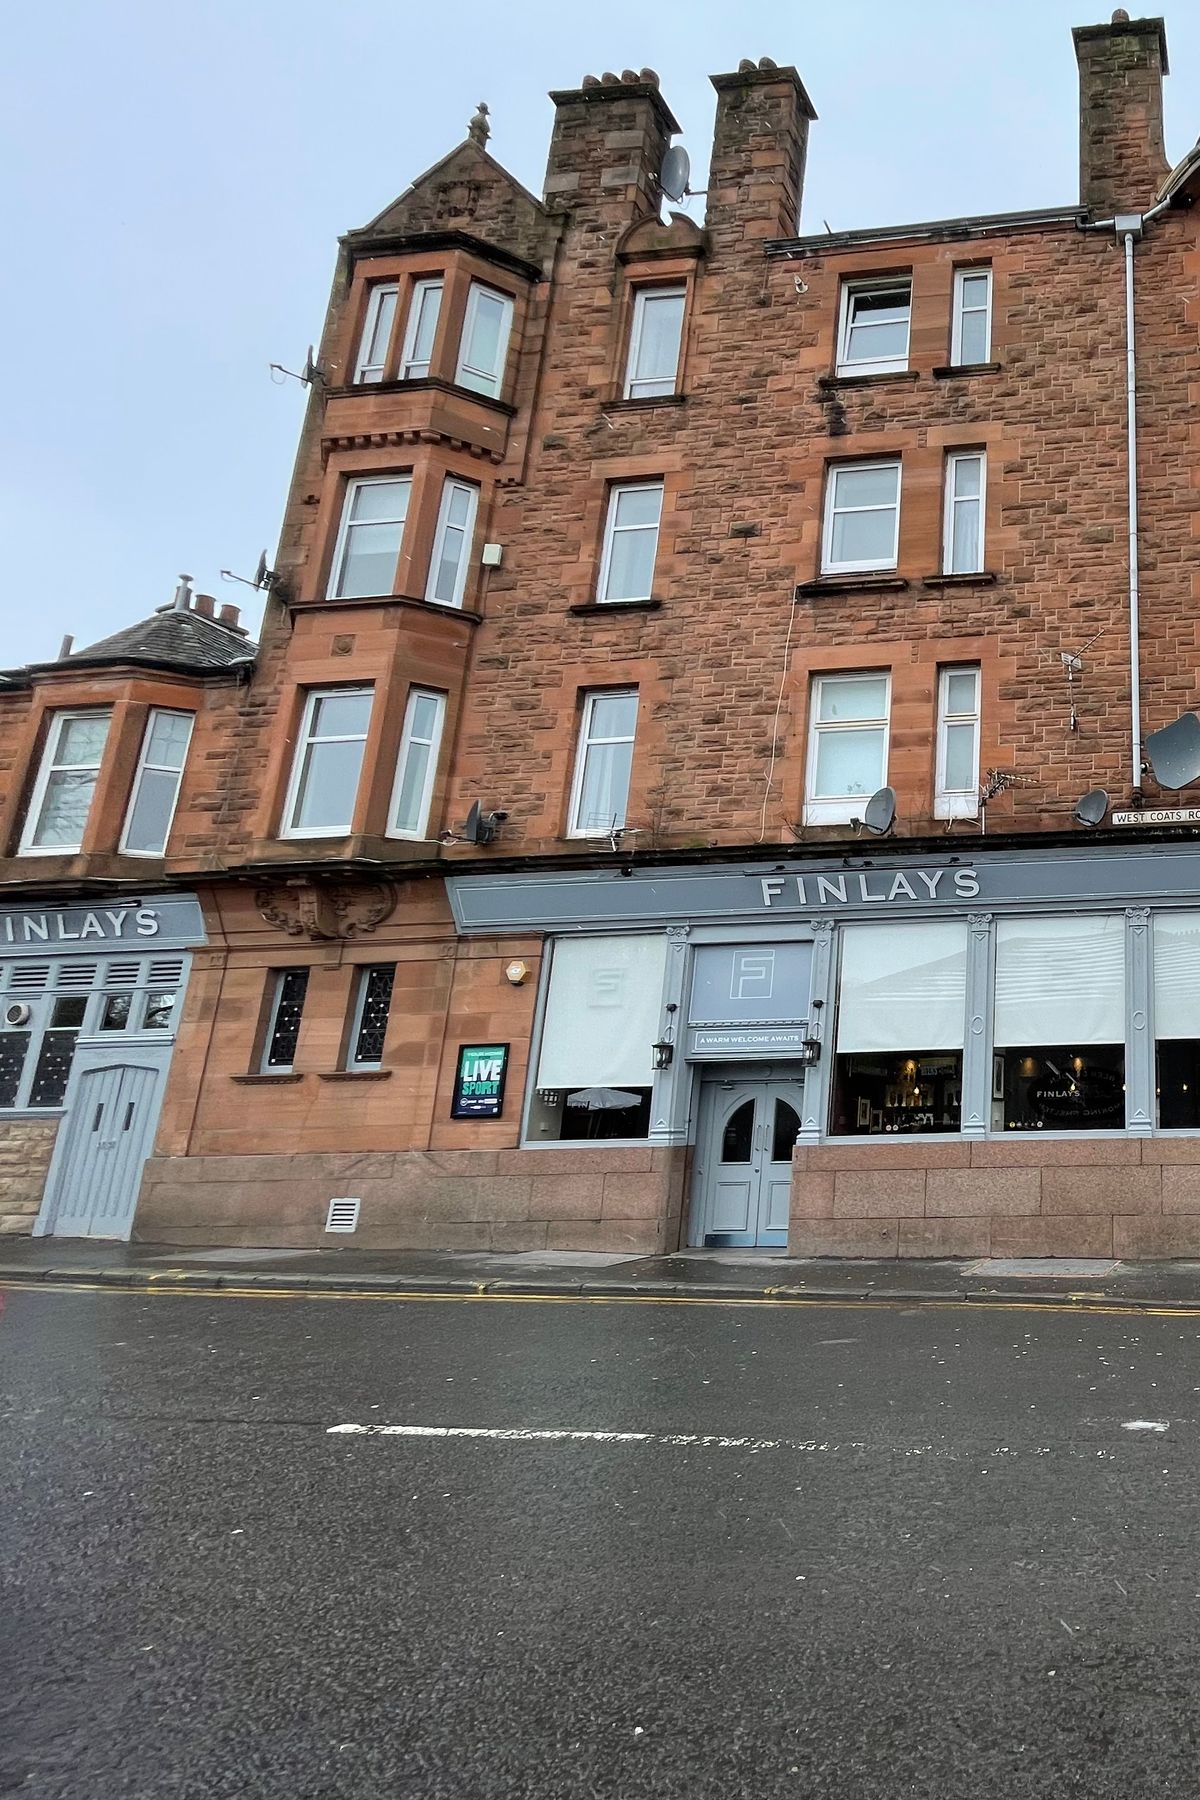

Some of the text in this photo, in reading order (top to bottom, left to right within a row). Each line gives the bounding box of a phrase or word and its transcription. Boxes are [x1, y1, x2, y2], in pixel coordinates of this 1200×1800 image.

[1116, 813, 1145, 823] WEST
[1150, 811, 1182, 821] COATS
[761, 869, 980, 906] FINLAYS
[463, 1060, 502, 1081] LIVE
[462, 1081, 499, 1095] SPORT
[1036, 1090, 1080, 1098] FINLAYS
